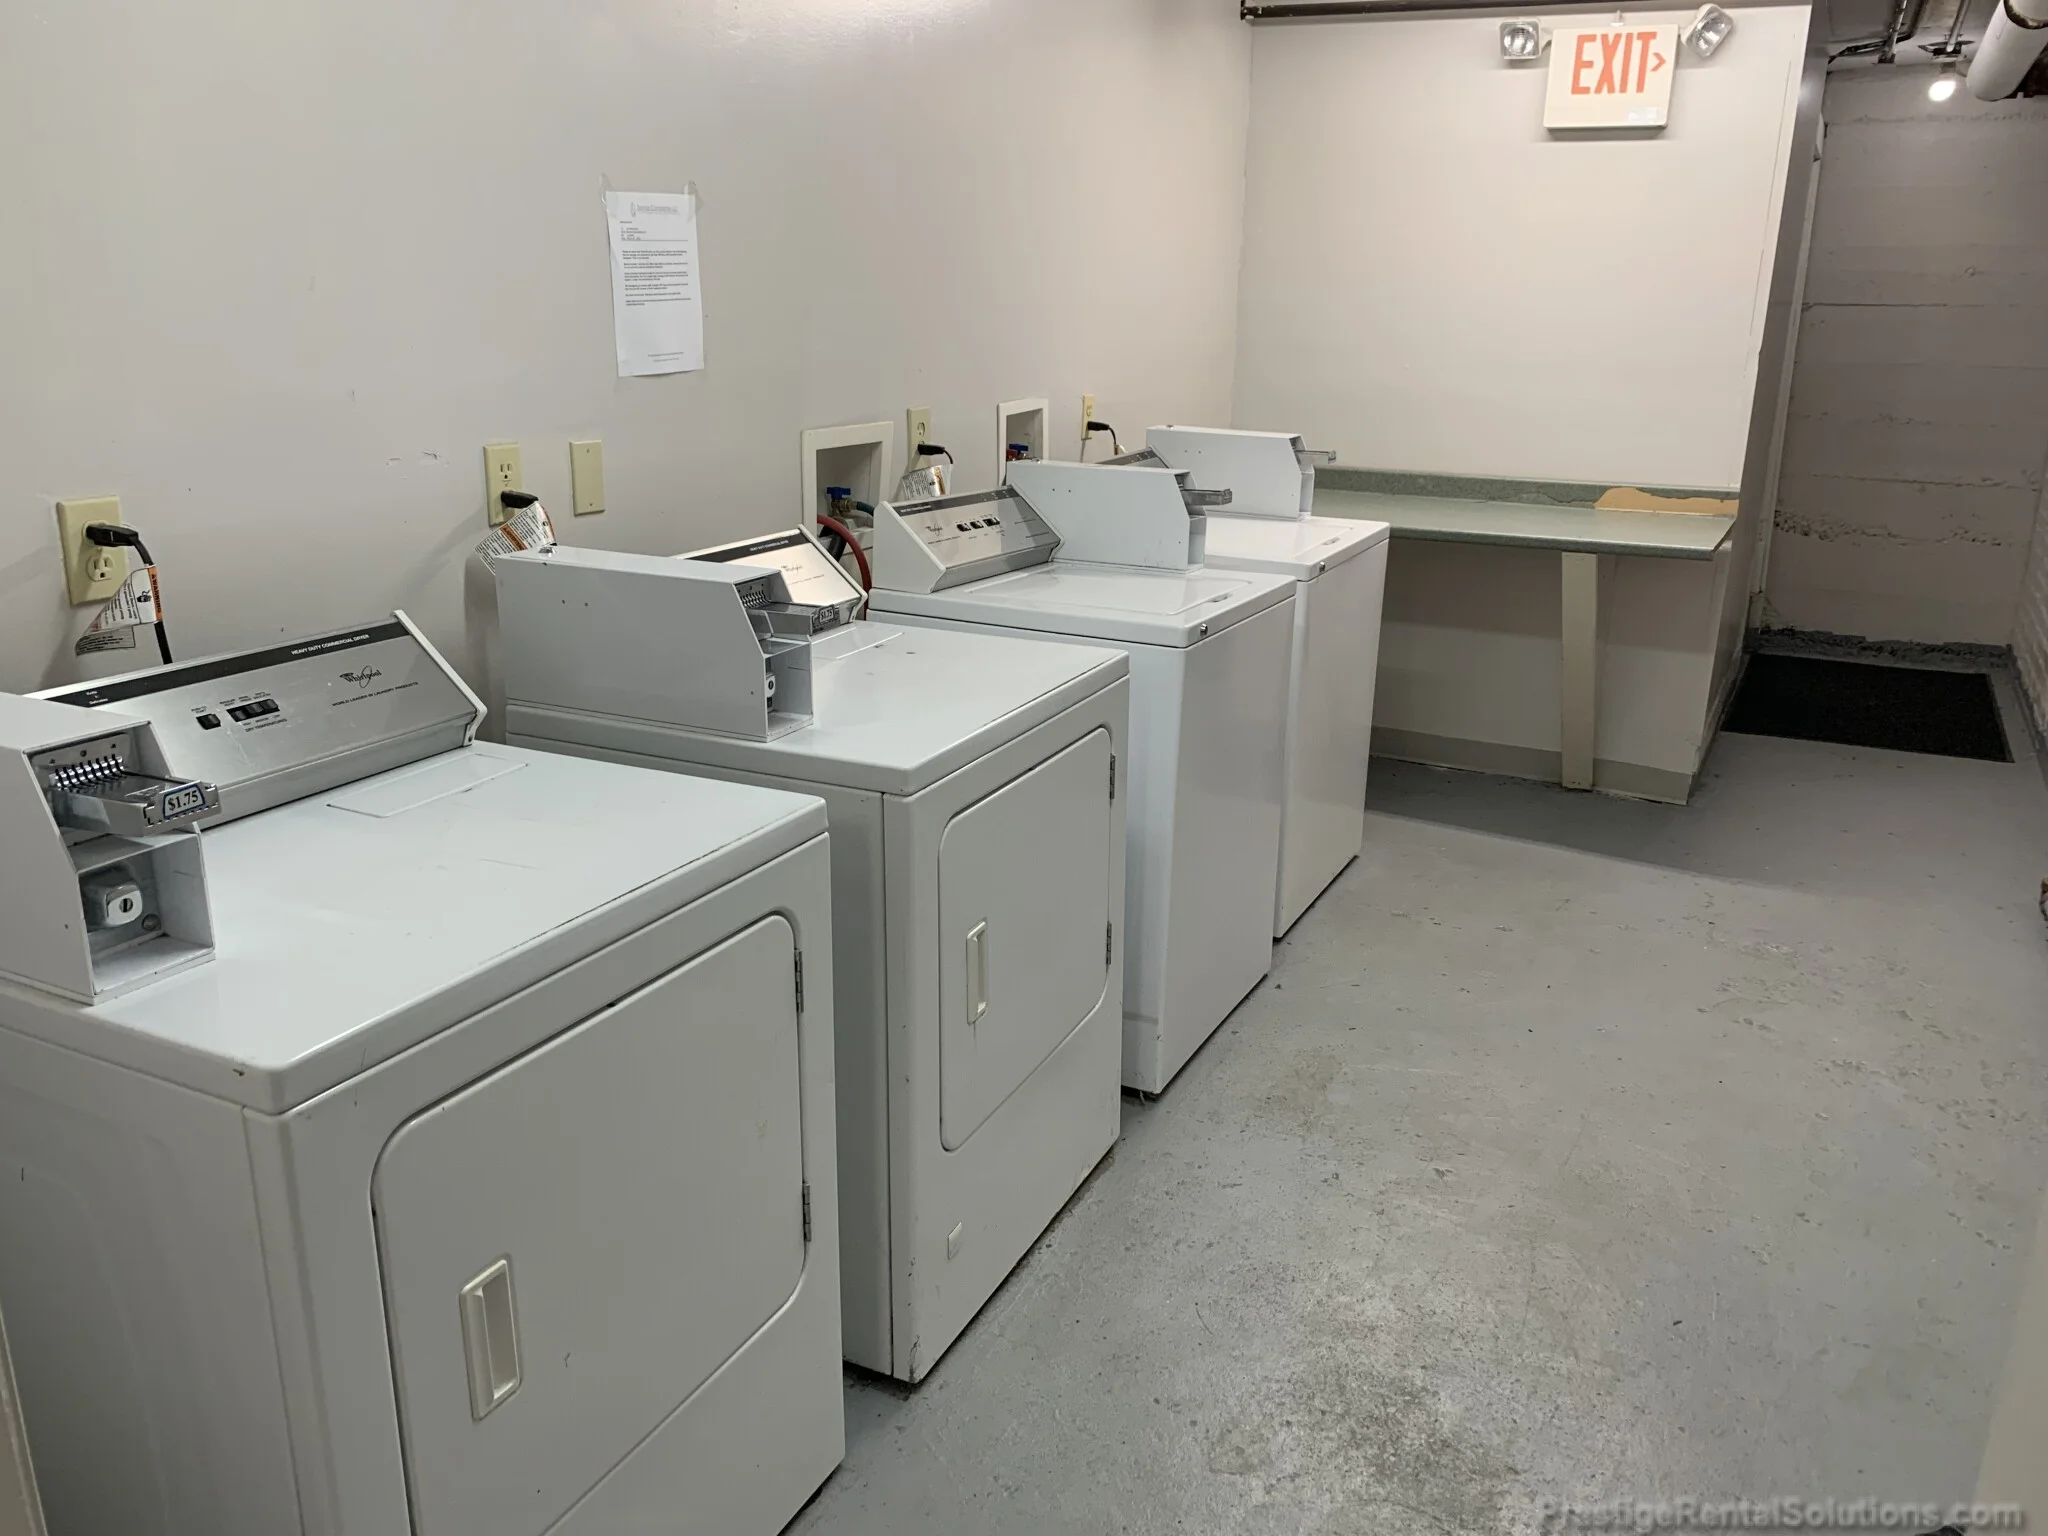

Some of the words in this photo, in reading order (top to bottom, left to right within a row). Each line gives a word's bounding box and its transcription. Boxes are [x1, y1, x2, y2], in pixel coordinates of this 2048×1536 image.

[1571, 31, 1658, 95] EXIT
[321, 638, 353, 649] COMMERCIAL
[343, 665, 382, 688] Whirlpool
[374, 688, 395, 696] LAUNDRY
[395, 682, 419, 690] PRODUCTS
[168, 790, 199, 811] $1.75
